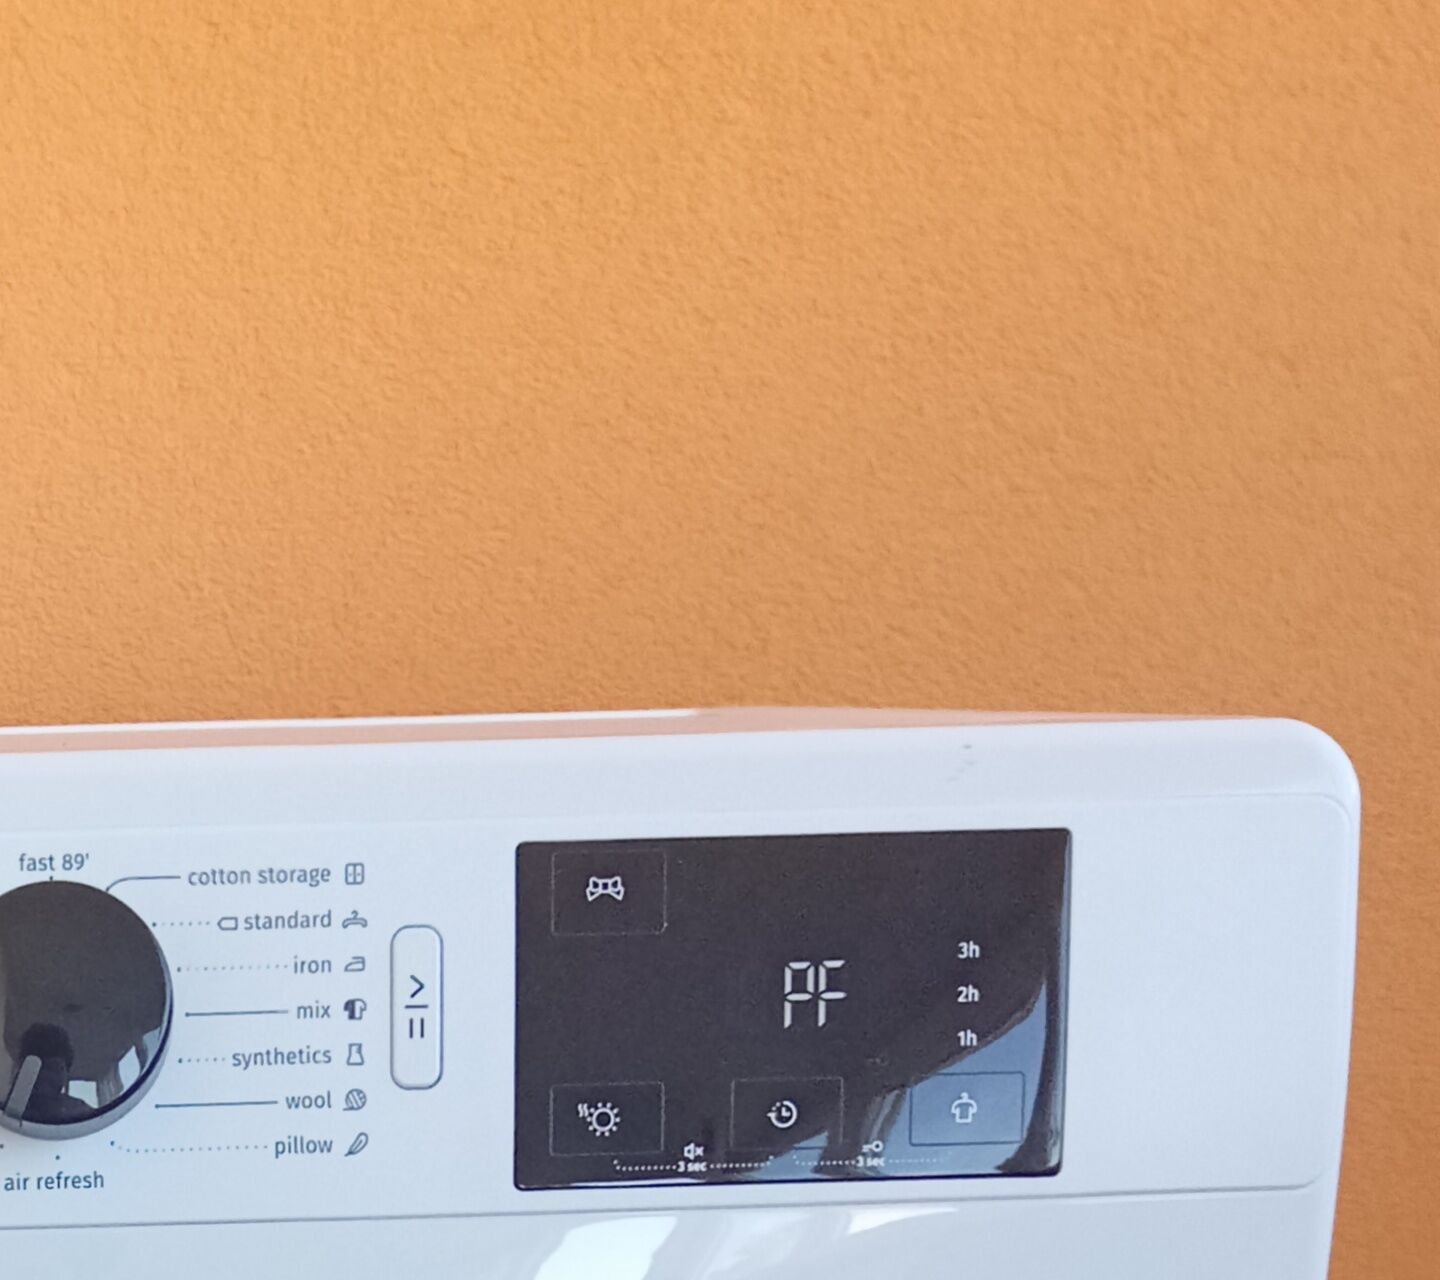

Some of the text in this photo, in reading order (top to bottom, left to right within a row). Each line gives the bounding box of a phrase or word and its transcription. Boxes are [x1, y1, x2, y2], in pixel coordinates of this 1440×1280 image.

[19, 852, 91, 872] fast 89'
[187, 865, 332, 888] cotton storage
[244, 910, 333, 930] standard
[957, 941, 981, 959] 3h
[293, 955, 333, 974] iron
[957, 985, 981, 1003] 2h
[296, 1000, 332, 1020] mix
[957, 1029, 978, 1047] 1h
[231, 1046, 333, 1071] synthetics
[285, 1091, 333, 1110] wool
[274, 1135, 334, 1159] pillow
[677, 1161, 708, 1173] 3 sec
[856, 1155, 886, 1168] 3 sec
[4, 1171, 105, 1191] air refresh
